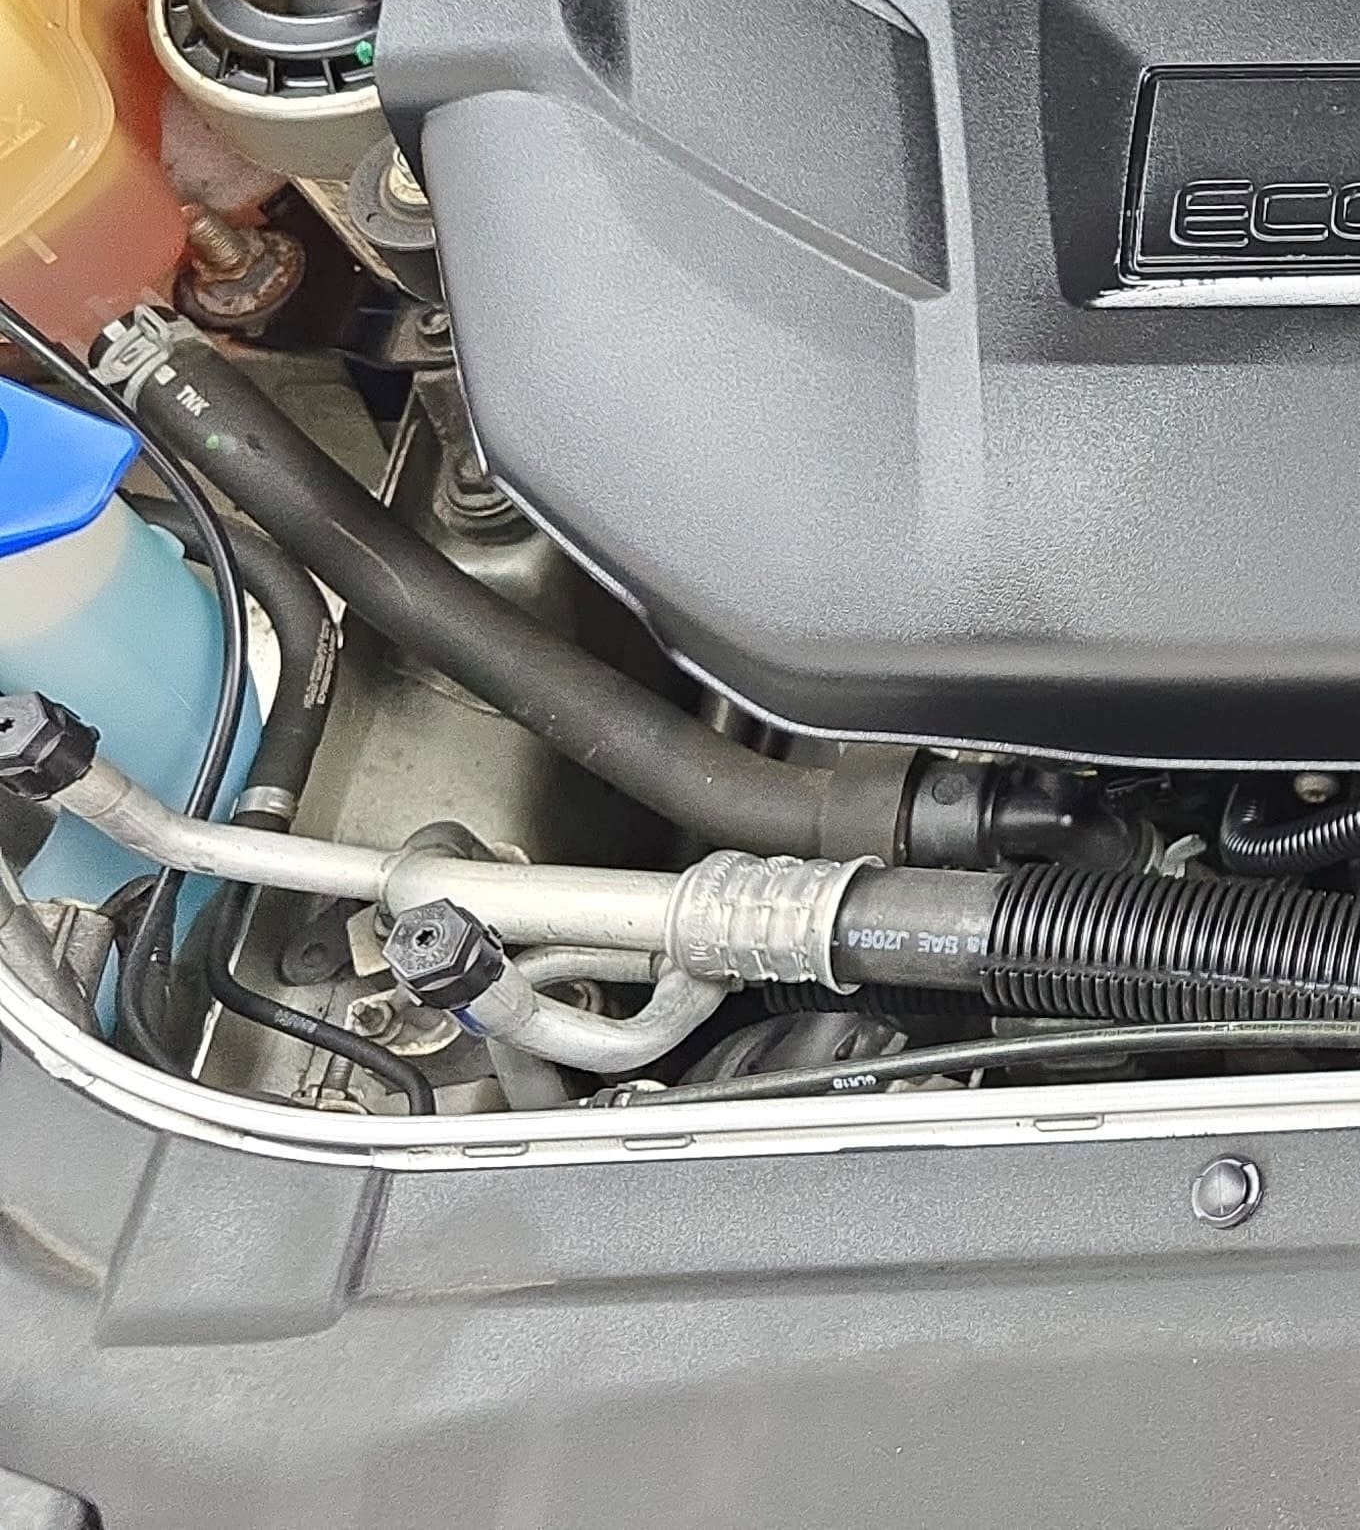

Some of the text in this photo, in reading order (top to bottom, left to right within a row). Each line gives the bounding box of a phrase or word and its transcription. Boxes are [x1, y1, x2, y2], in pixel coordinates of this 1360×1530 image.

[174, 383, 210, 419] TKK
[846, 928, 910, 951] J2064
[916, 931, 960, 955] SAE
